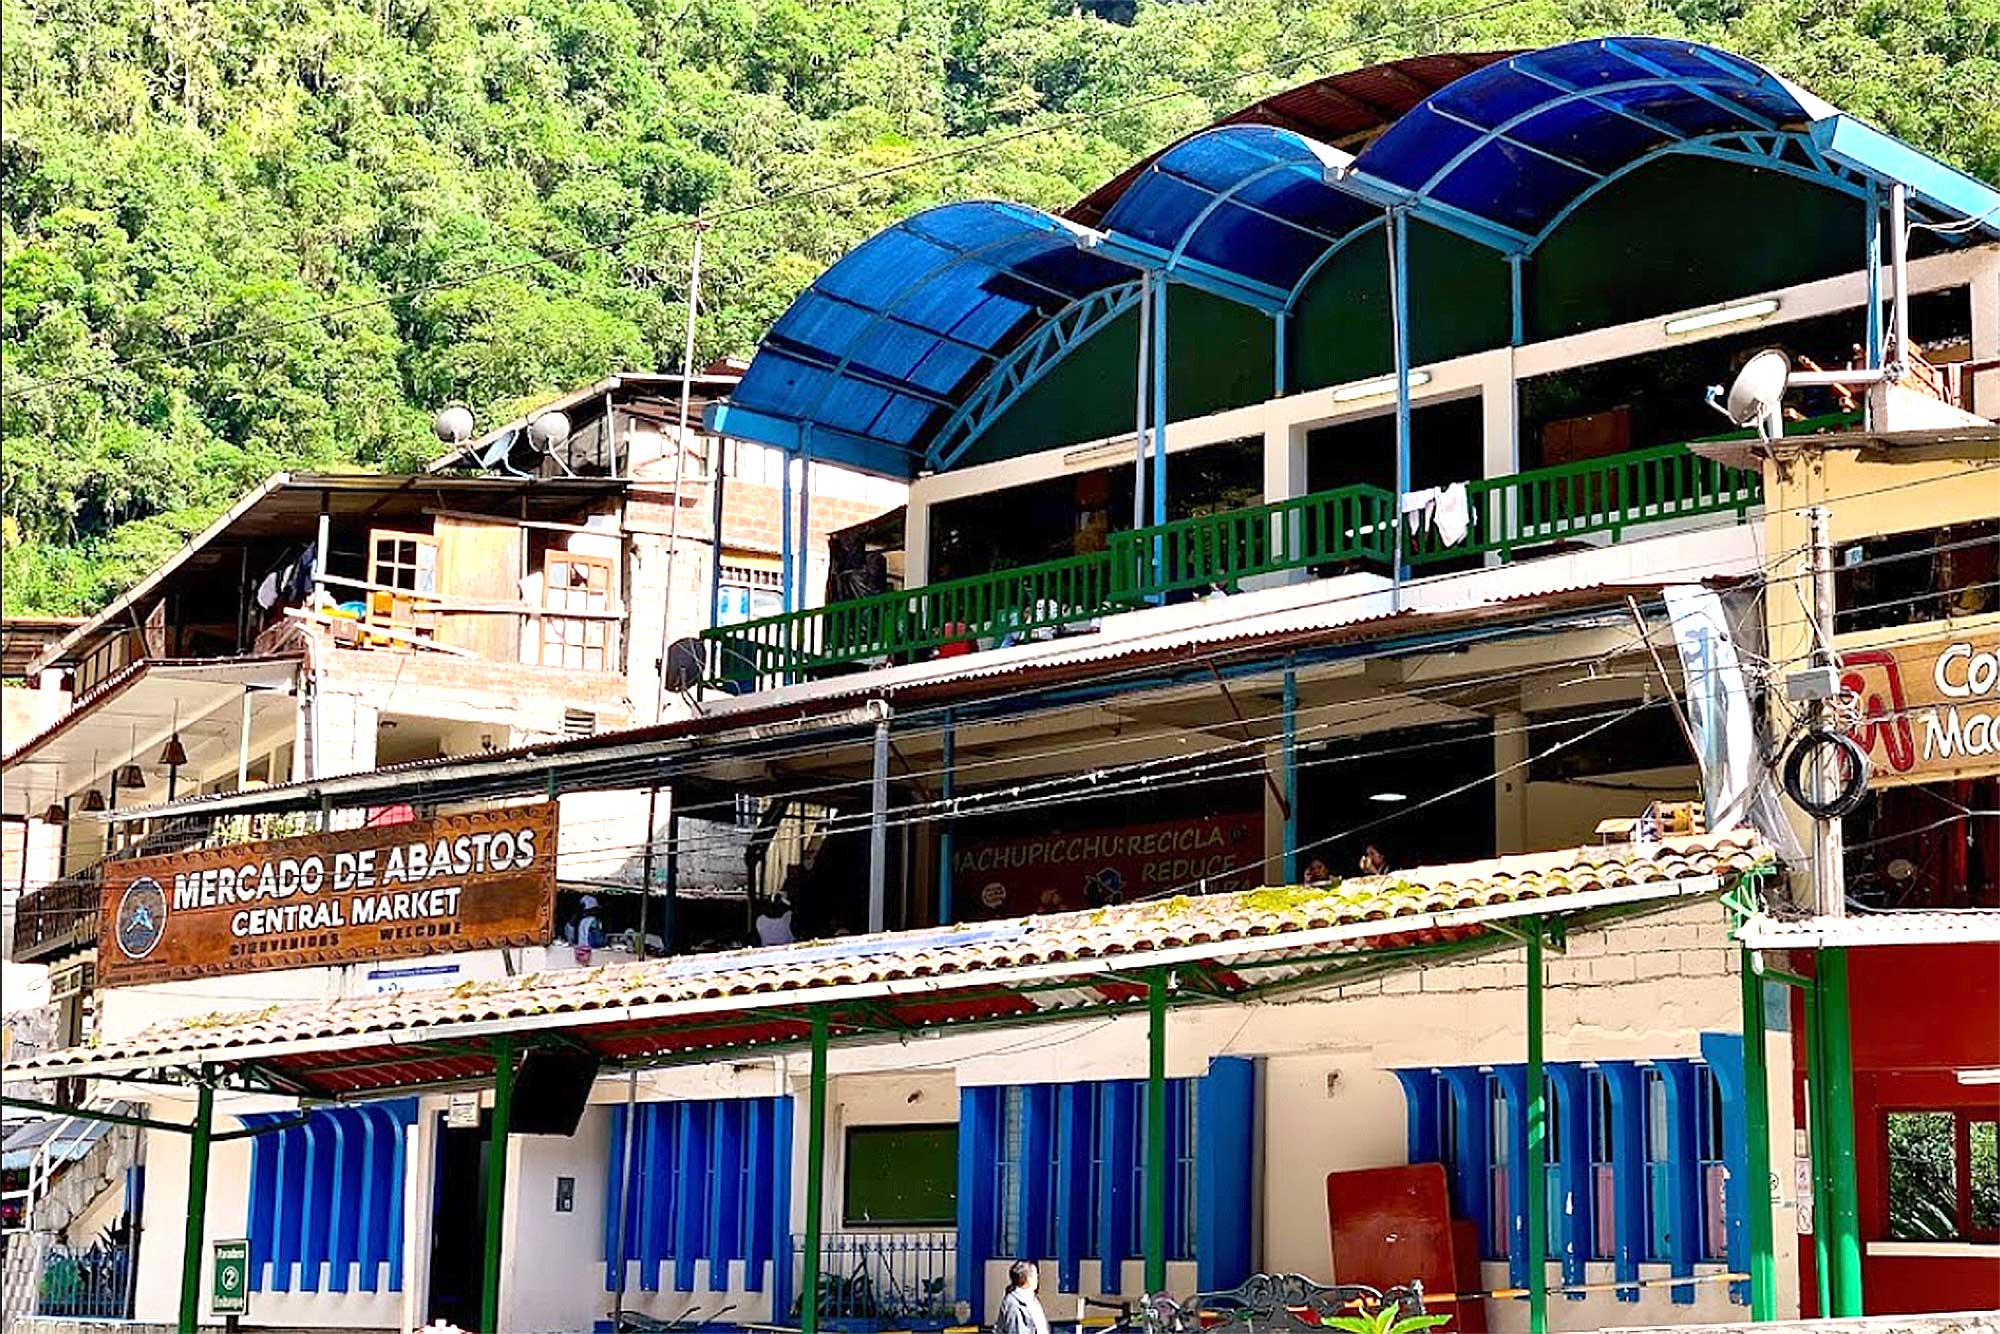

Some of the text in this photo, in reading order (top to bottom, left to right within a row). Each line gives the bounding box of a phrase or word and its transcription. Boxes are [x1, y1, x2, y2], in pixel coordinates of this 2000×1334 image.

[1934, 643, 2000, 697] Co
[173, 829, 536, 910] MERCADO DE ABASTOS
[231, 887, 461, 937] CENTRAL MARKET
[379, 921, 462, 941] WELCOME
